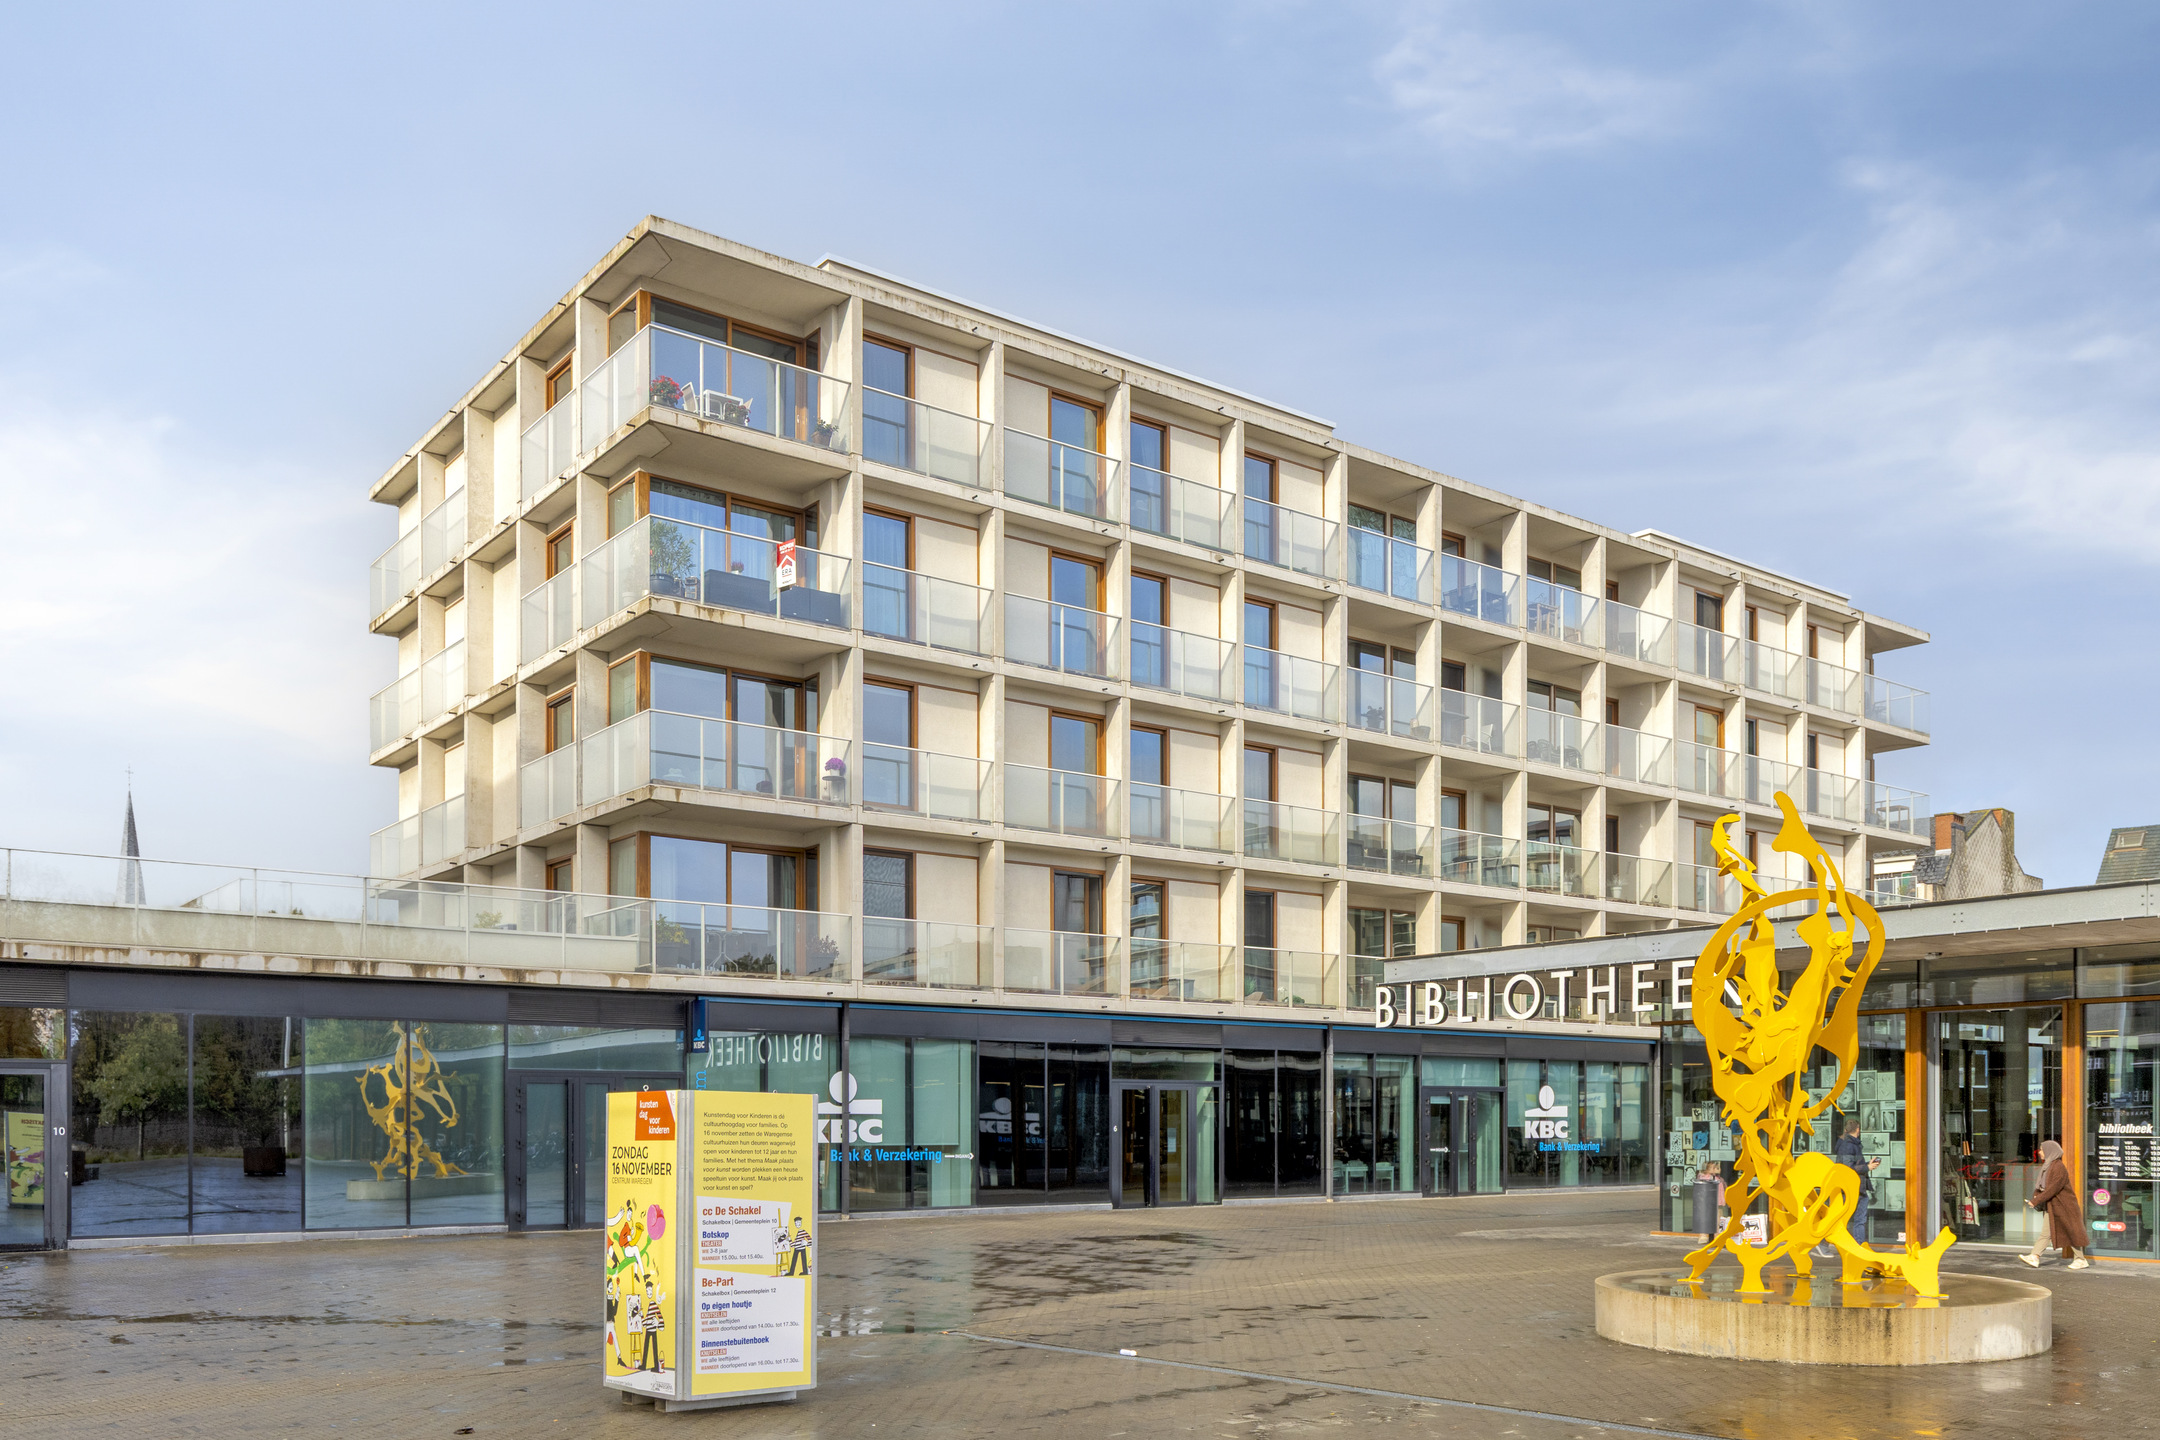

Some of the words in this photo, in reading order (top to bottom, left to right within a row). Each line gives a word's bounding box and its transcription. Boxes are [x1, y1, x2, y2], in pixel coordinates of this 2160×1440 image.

[1375, 960, 1742, 1028] BIBLIOTHEE
[639, 1110, 648, 1120] dag
[53, 1126, 66, 1136] 10
[649, 1126, 669, 1134] kinderen
[1525, 1120, 1568, 1138] KBC
[2099, 1123, 2153, 1133] bibliotheek
[1539, 1142, 1556, 1152] Bank
[1557, 1142, 1562, 1151] &
[1564, 1142, 1600, 1152] Verzekering
[612, 1147, 648, 1159] ZONDAG
[864, 1149, 872, 1161] &
[876, 1148, 942, 1163] Verzekering
[612, 1162, 619, 1174] 16
[622, 1163, 672, 1175] NOVEMBER
[715, 1206, 726, 1216] De
[728, 1206, 761, 1215] Schakel
[702, 1231, 730, 1240] Botskop
[702, 1277, 734, 1287] Be-Part
[702, 1302, 711, 1311] Op
[712, 1301, 730, 1310] eigen
[732, 1300, 753, 1308] houtje
[701, 1336, 769, 1348] Binnenstebuitenboek
